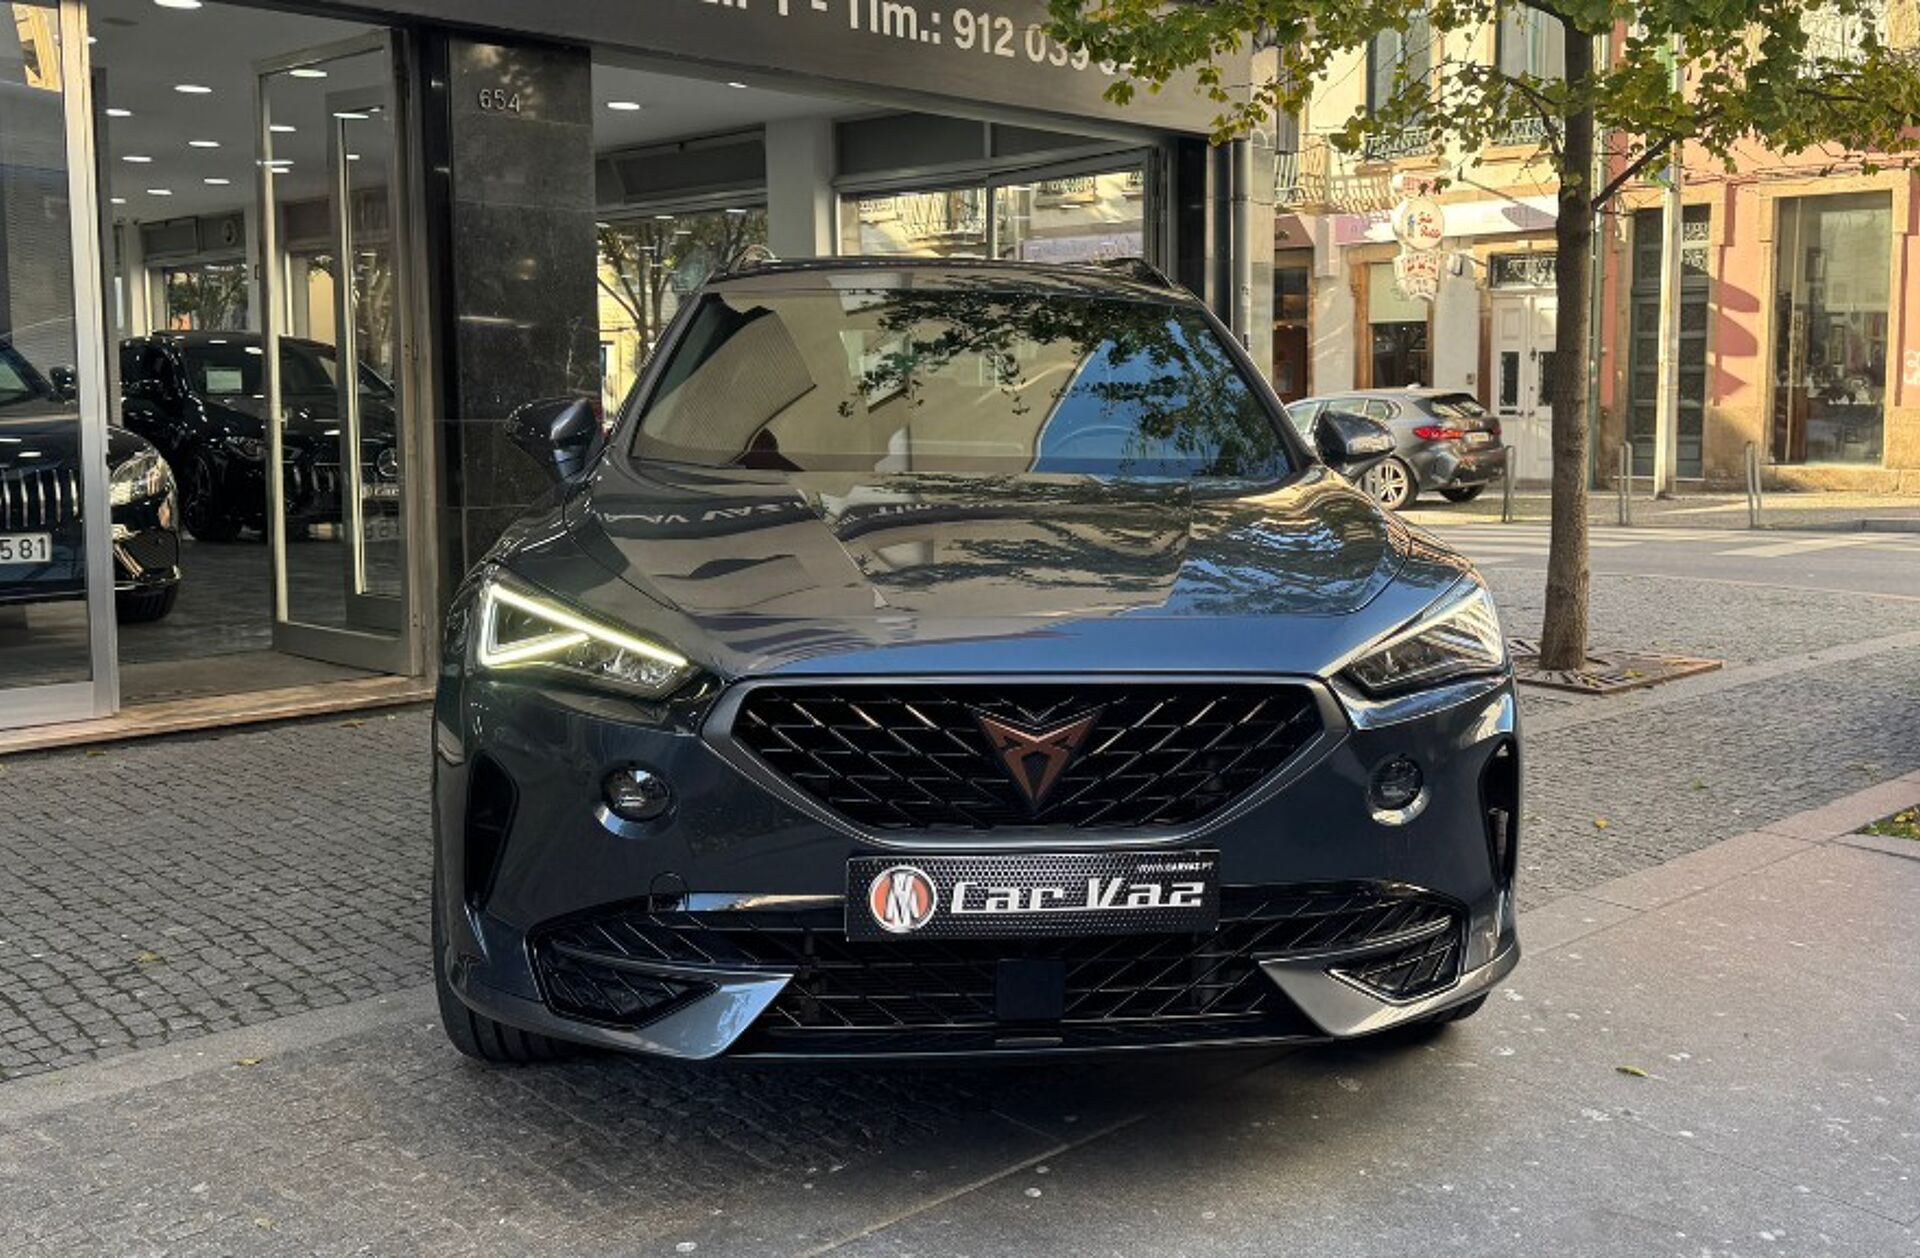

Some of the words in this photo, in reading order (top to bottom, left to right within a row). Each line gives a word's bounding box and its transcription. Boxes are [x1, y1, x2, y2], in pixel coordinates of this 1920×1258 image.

[953, 8, 1015, 58] 912
[479, 88, 520, 112] 654
[951, 880, 1063, 914] Car
